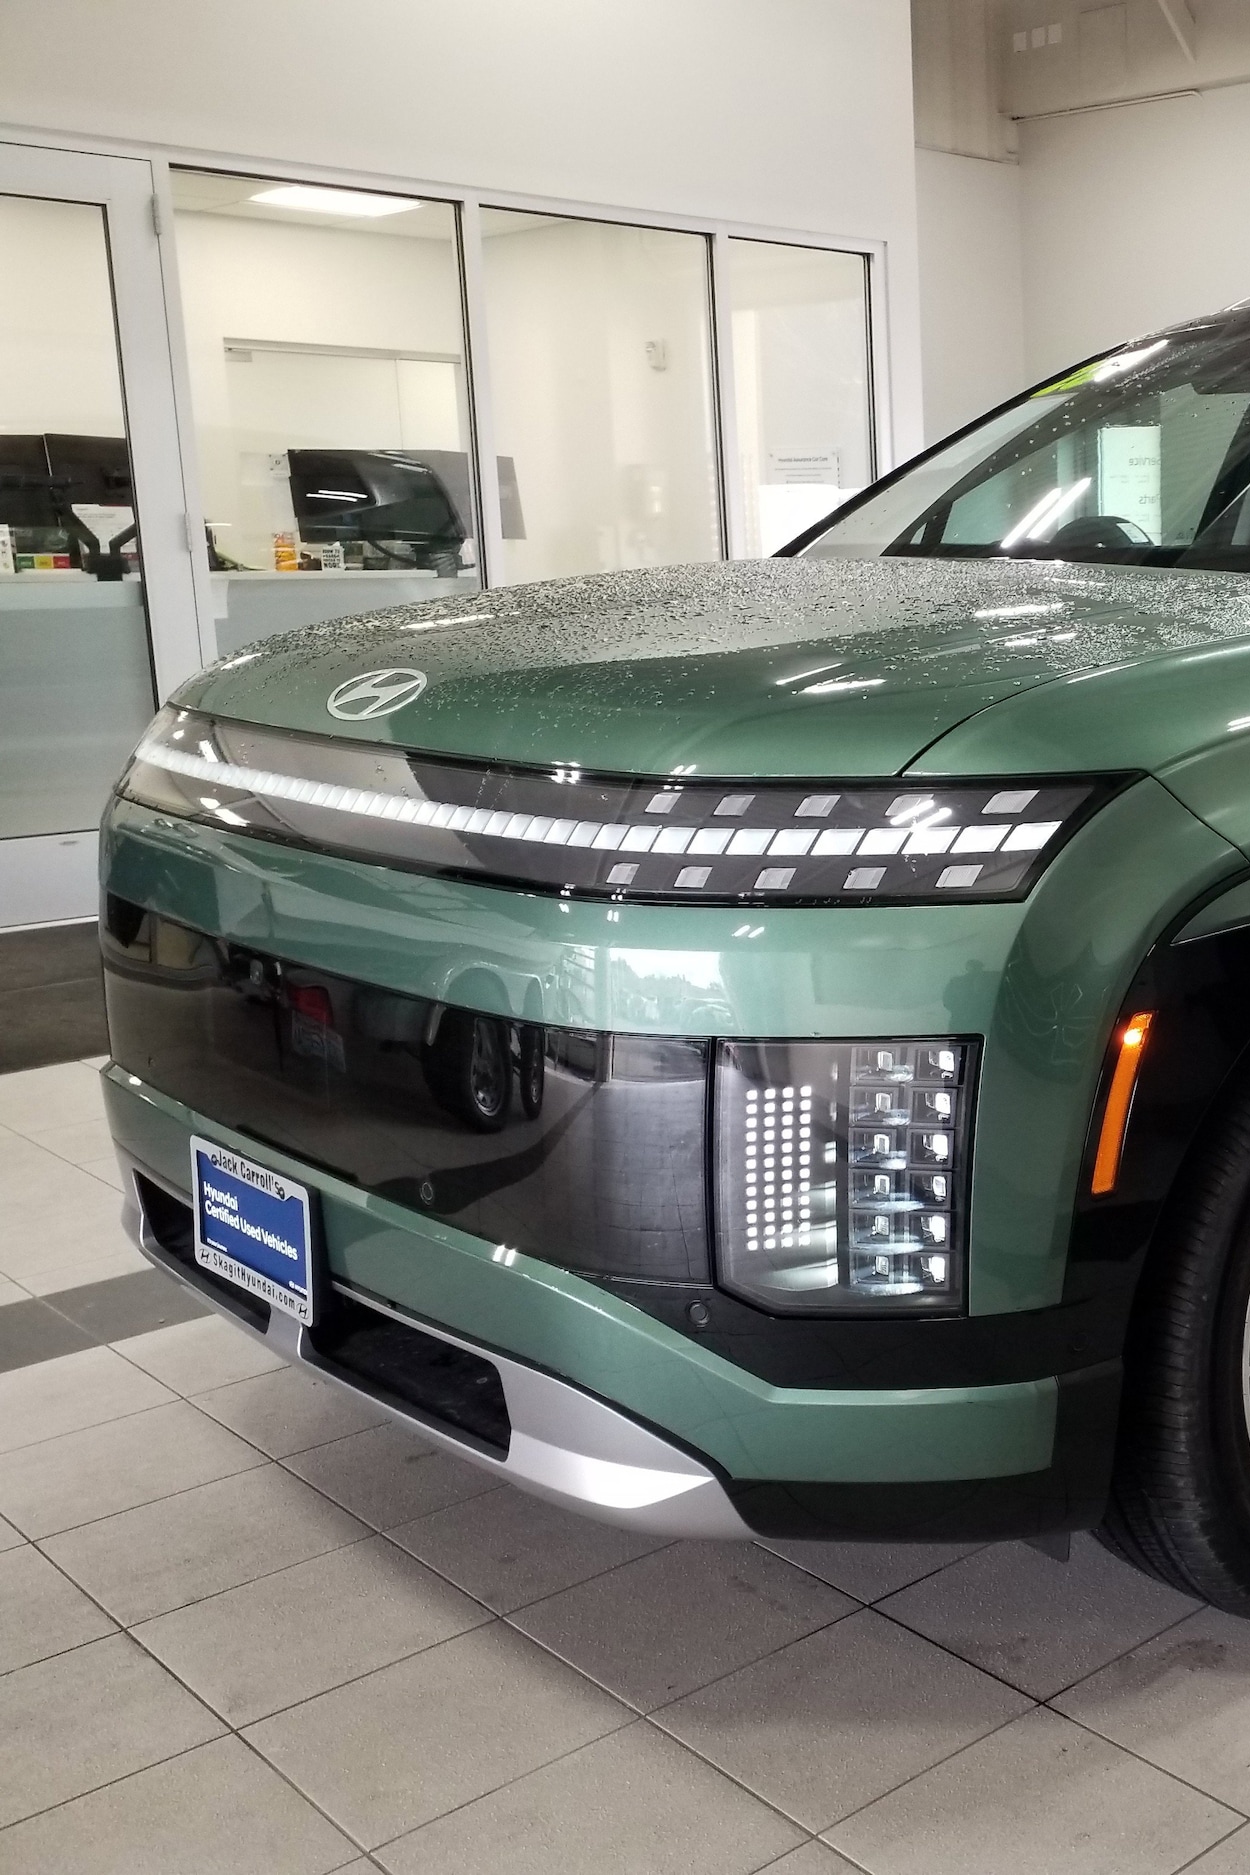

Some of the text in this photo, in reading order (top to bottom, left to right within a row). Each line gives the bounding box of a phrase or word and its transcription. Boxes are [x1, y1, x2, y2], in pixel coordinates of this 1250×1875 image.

[203, 1181, 239, 1212] Hyundai
[217, 1151, 281, 1196] Jack Carroll's
[204, 1200, 240, 1230] Certified
[240, 1217, 261, 1242] Used
[261, 1228, 298, 1261] Vehicles
[212, 1252, 296, 1311] SkagitHyundai.com
